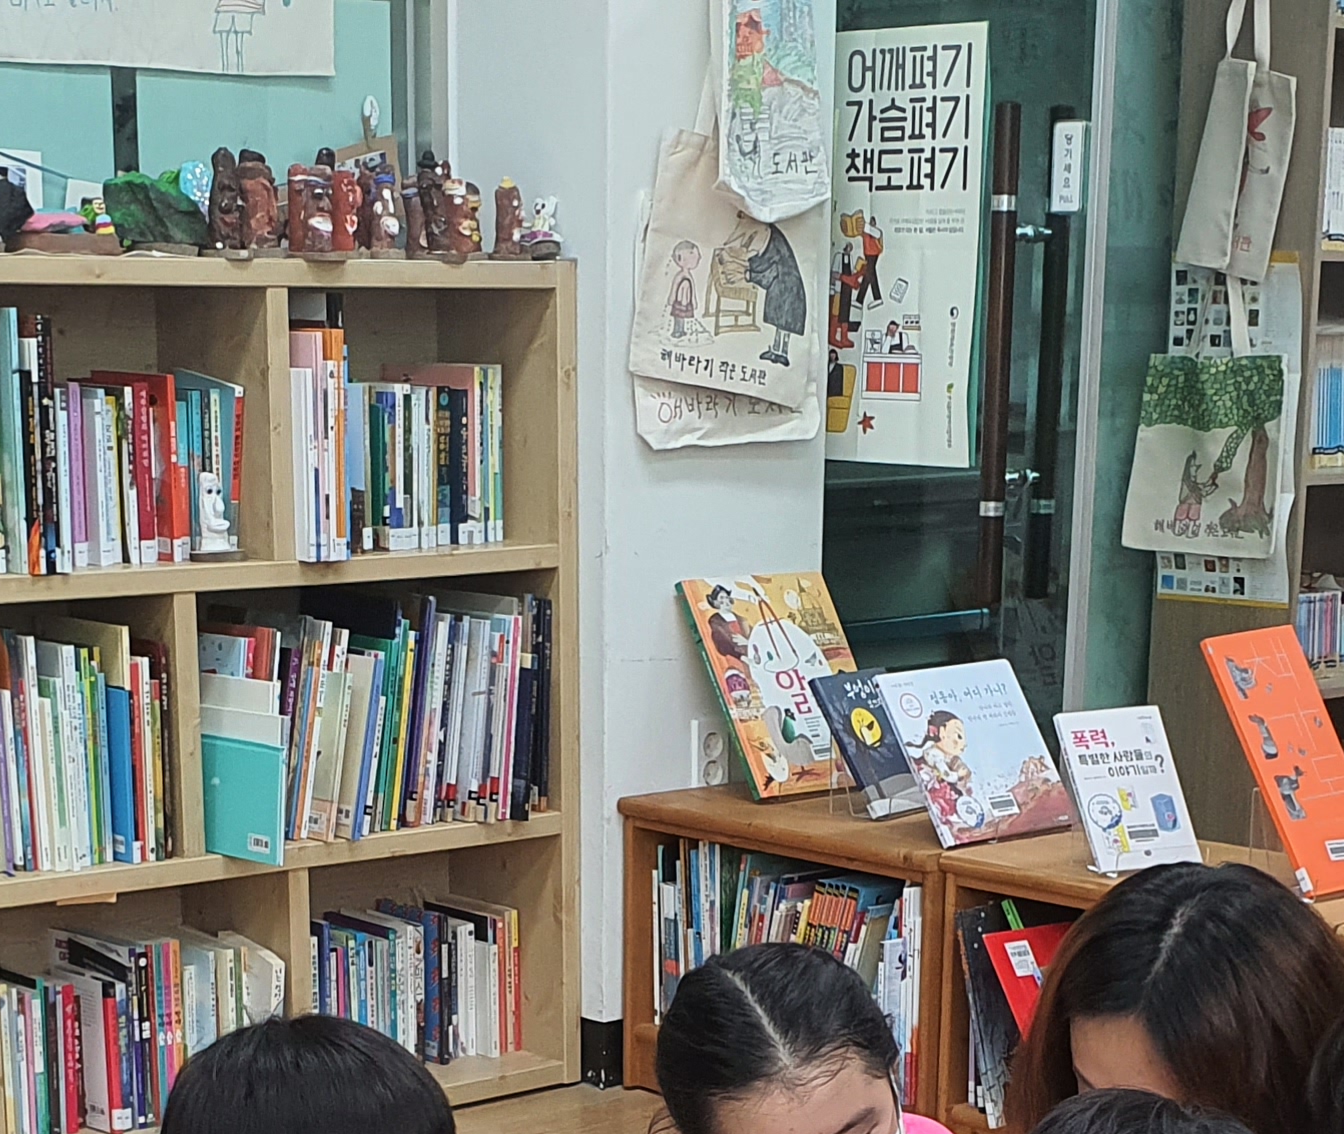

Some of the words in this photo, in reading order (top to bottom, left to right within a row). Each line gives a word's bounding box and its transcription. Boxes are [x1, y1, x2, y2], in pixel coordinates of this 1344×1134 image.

[848, 42, 973, 93] 어깨펴기
[845, 93, 971, 143] 가슴펴기
[771, 151, 818, 175] 도서관
[845, 145, 969, 193] 책도펴기
[1062, 133, 1074, 189] 당기세요
[660, 348, 715, 378] 해바라기
[740, 365, 767, 386] 도서관
[775, 669, 813, 715] 알
[844, 678, 876, 700] 부엉이
[963, 685, 982, 699] 어디
[985, 682, 1008, 697] 가니?
[1071, 728, 1115, 750] 폭력,
